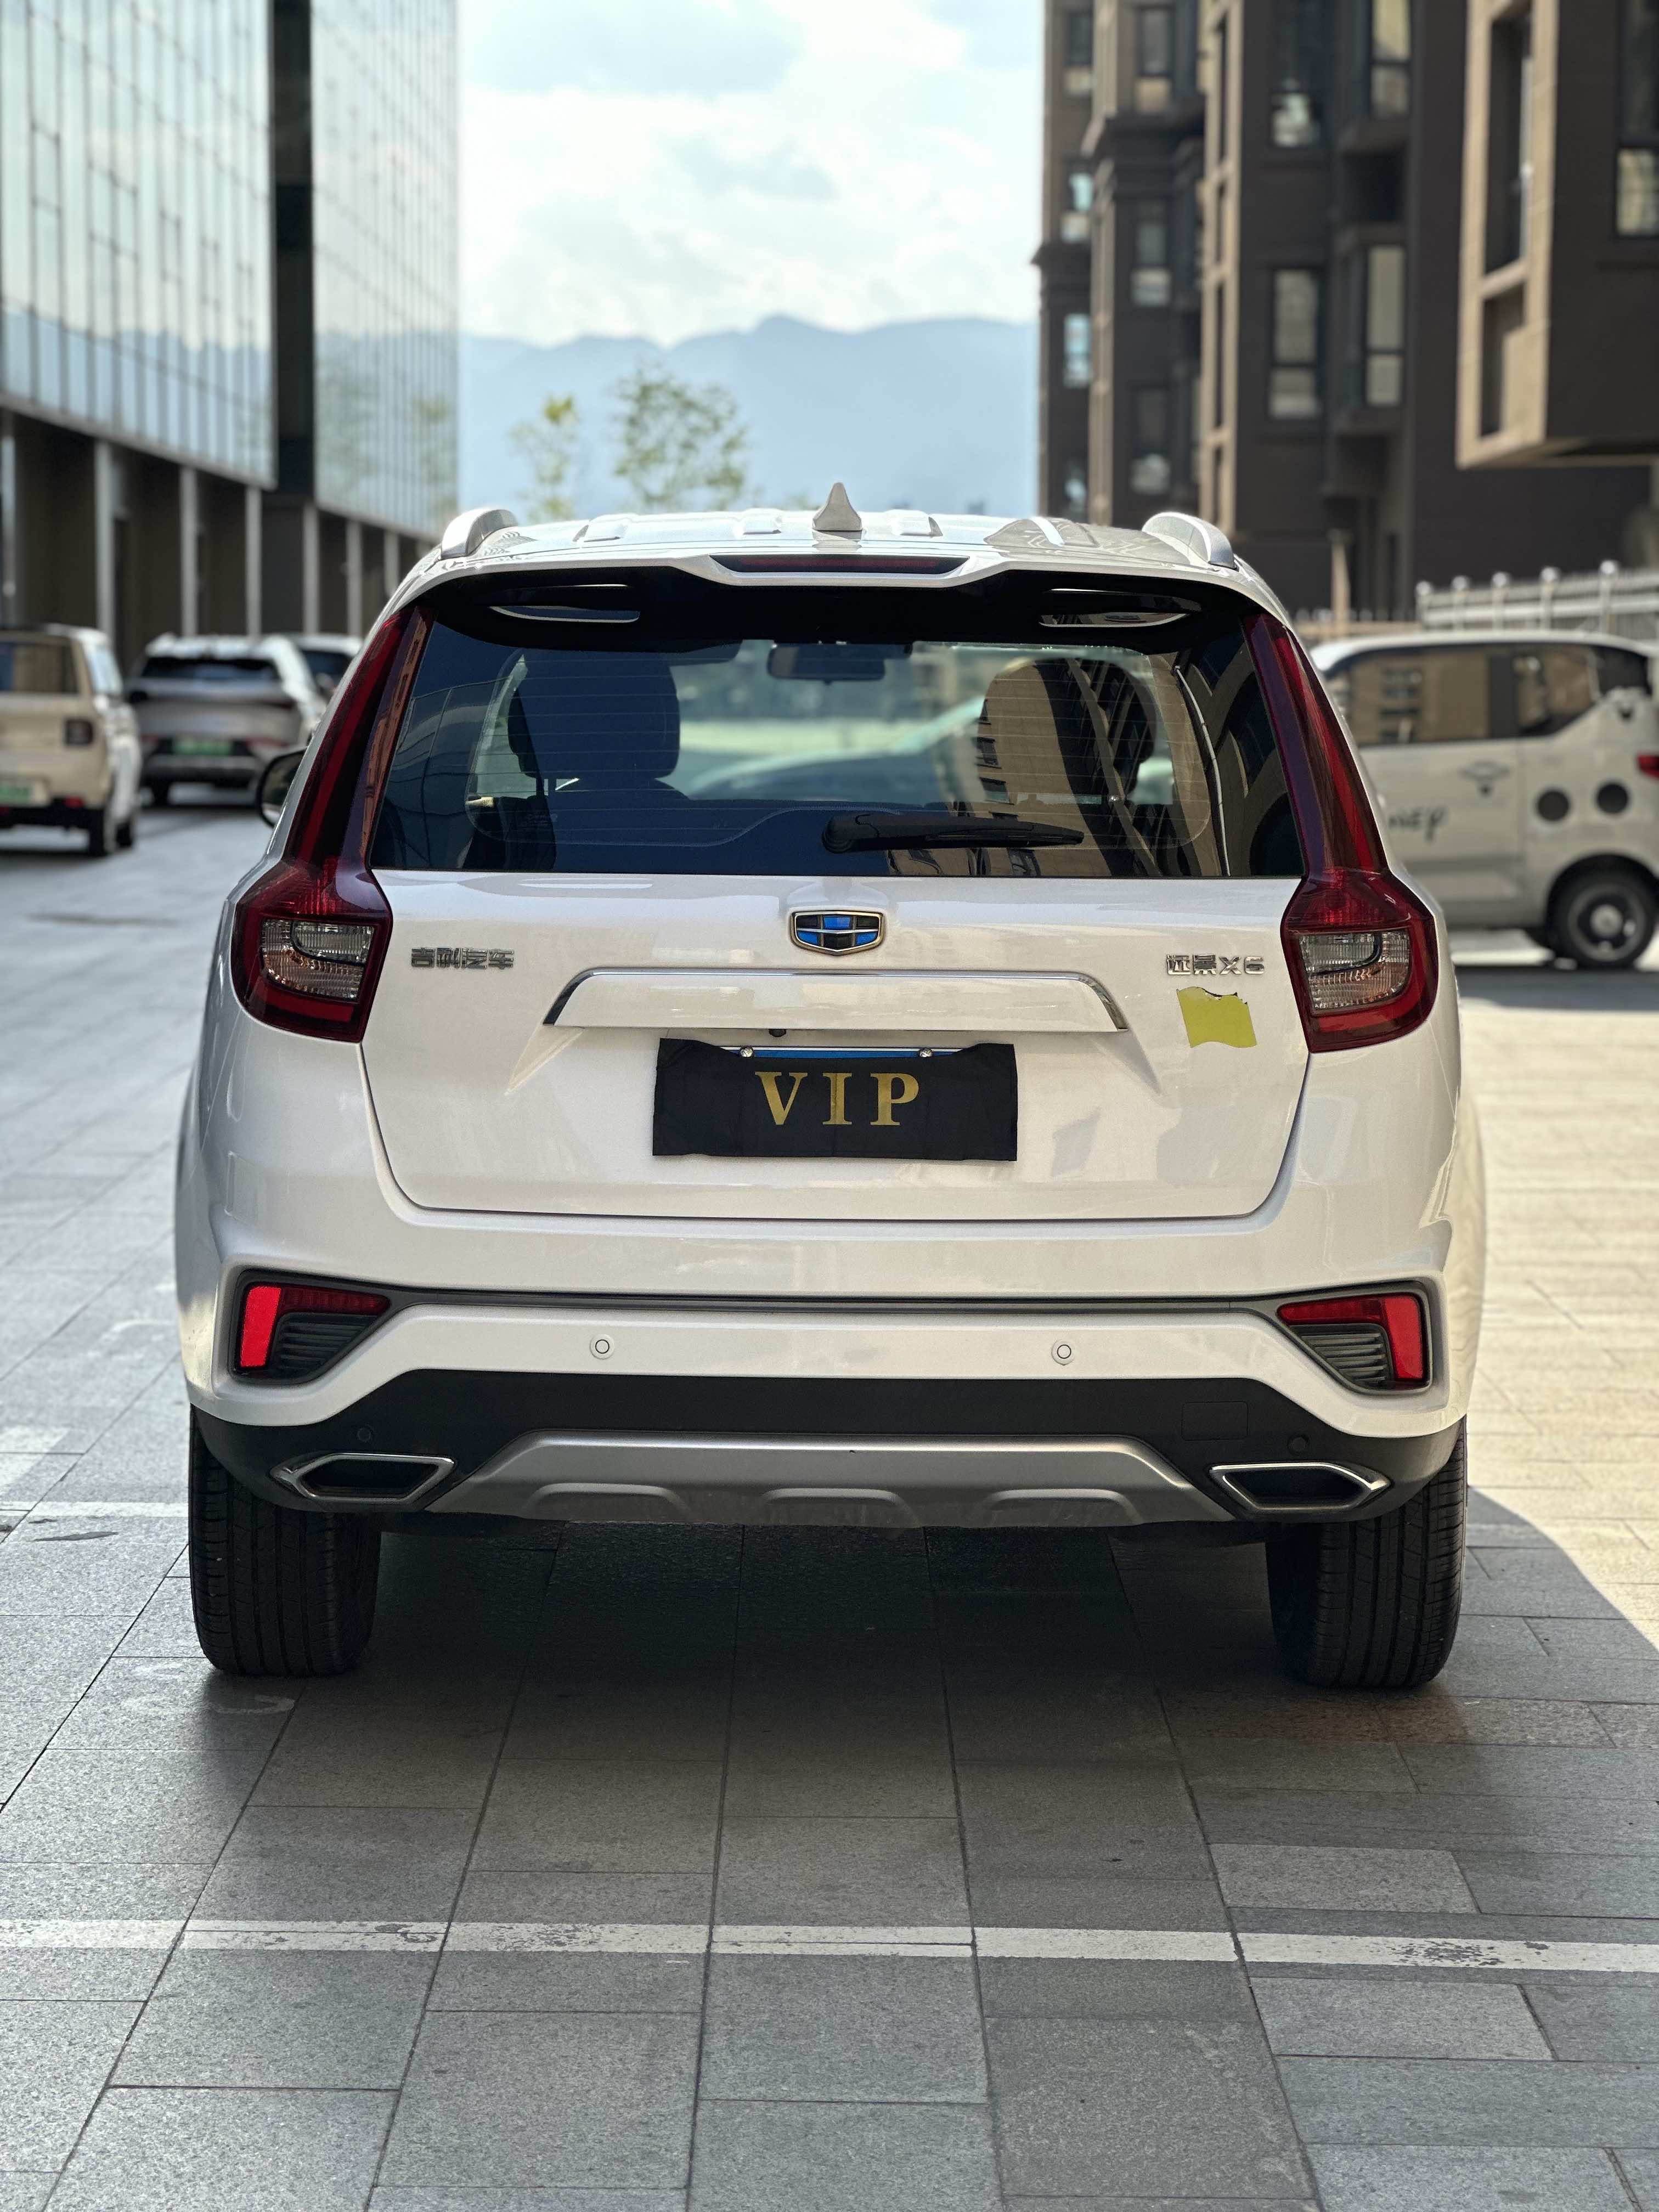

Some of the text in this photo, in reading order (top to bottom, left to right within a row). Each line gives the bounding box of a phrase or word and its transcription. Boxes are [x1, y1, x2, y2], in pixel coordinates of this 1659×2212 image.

[411, 947, 514, 969] 吉利汽车
[754, 1071, 919, 1125] VIP
